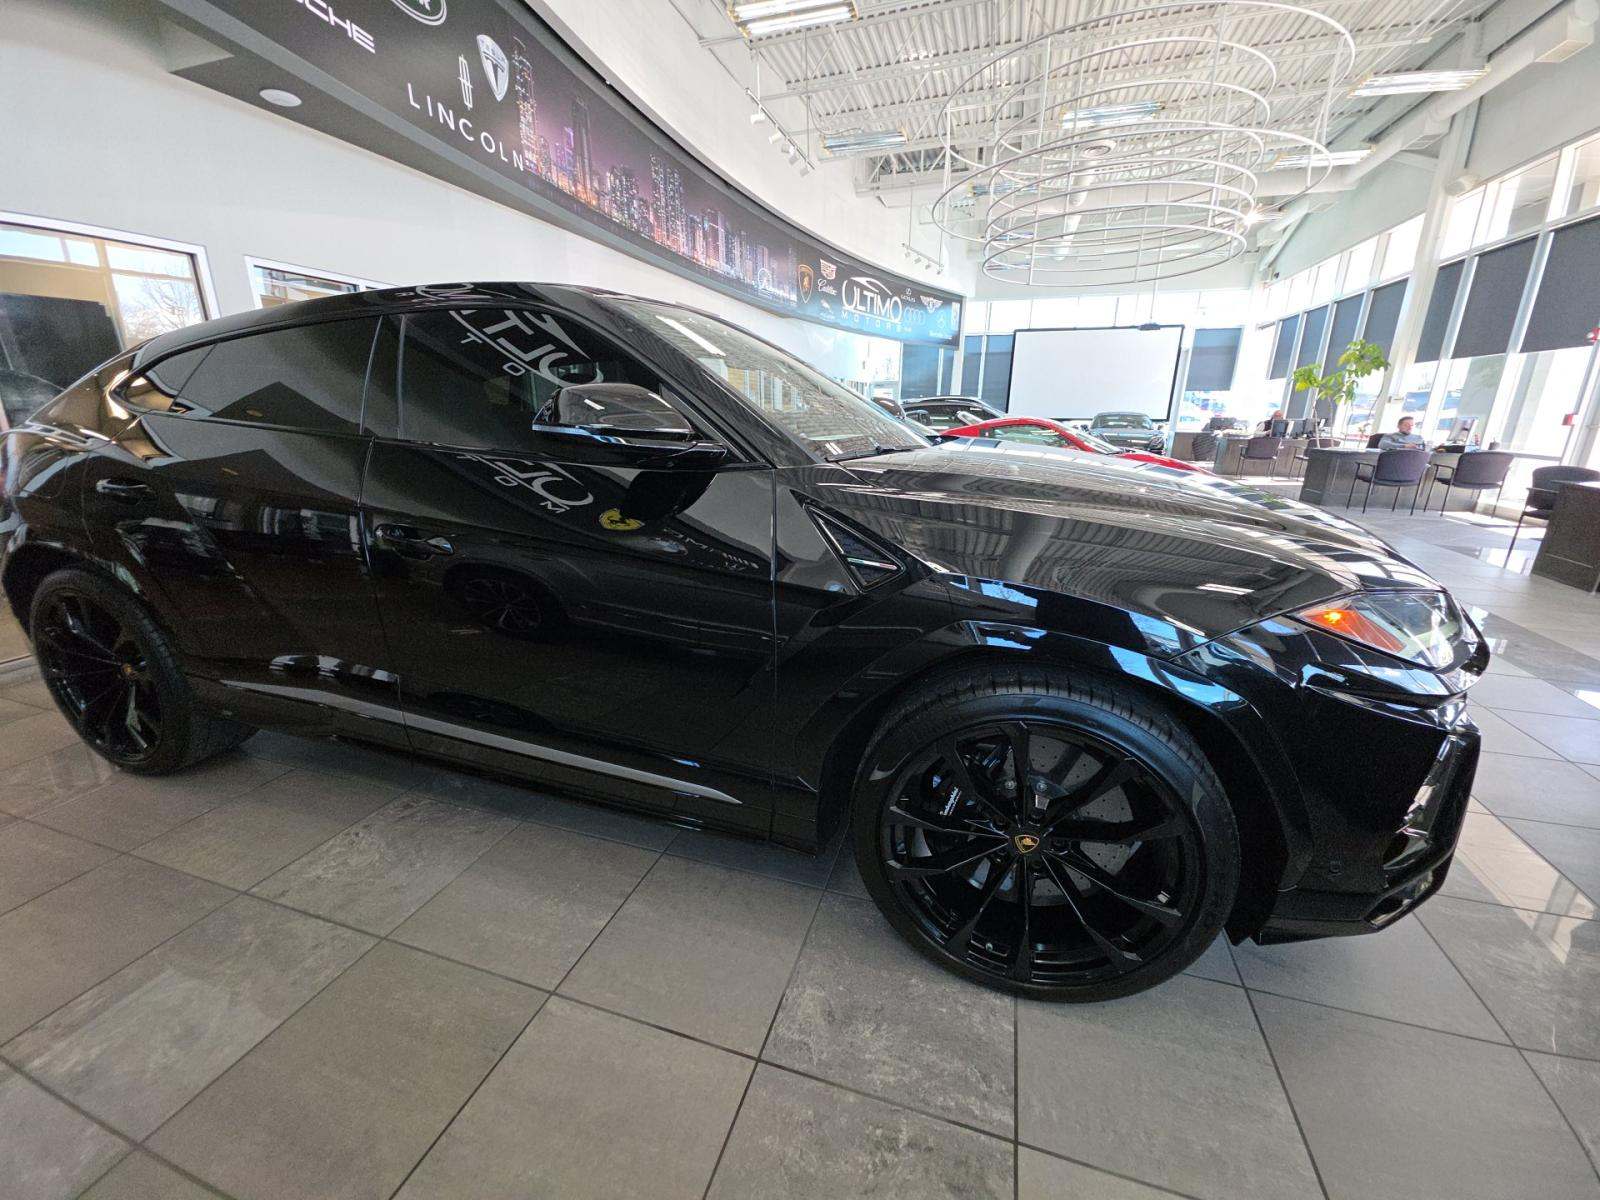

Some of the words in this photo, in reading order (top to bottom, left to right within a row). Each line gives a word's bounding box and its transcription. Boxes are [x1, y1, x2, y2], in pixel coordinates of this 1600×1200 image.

[297, 0, 376, 54] CHE
[407, 82, 524, 171] LINCOLN
[841, 279, 903, 323] ULTIMO
